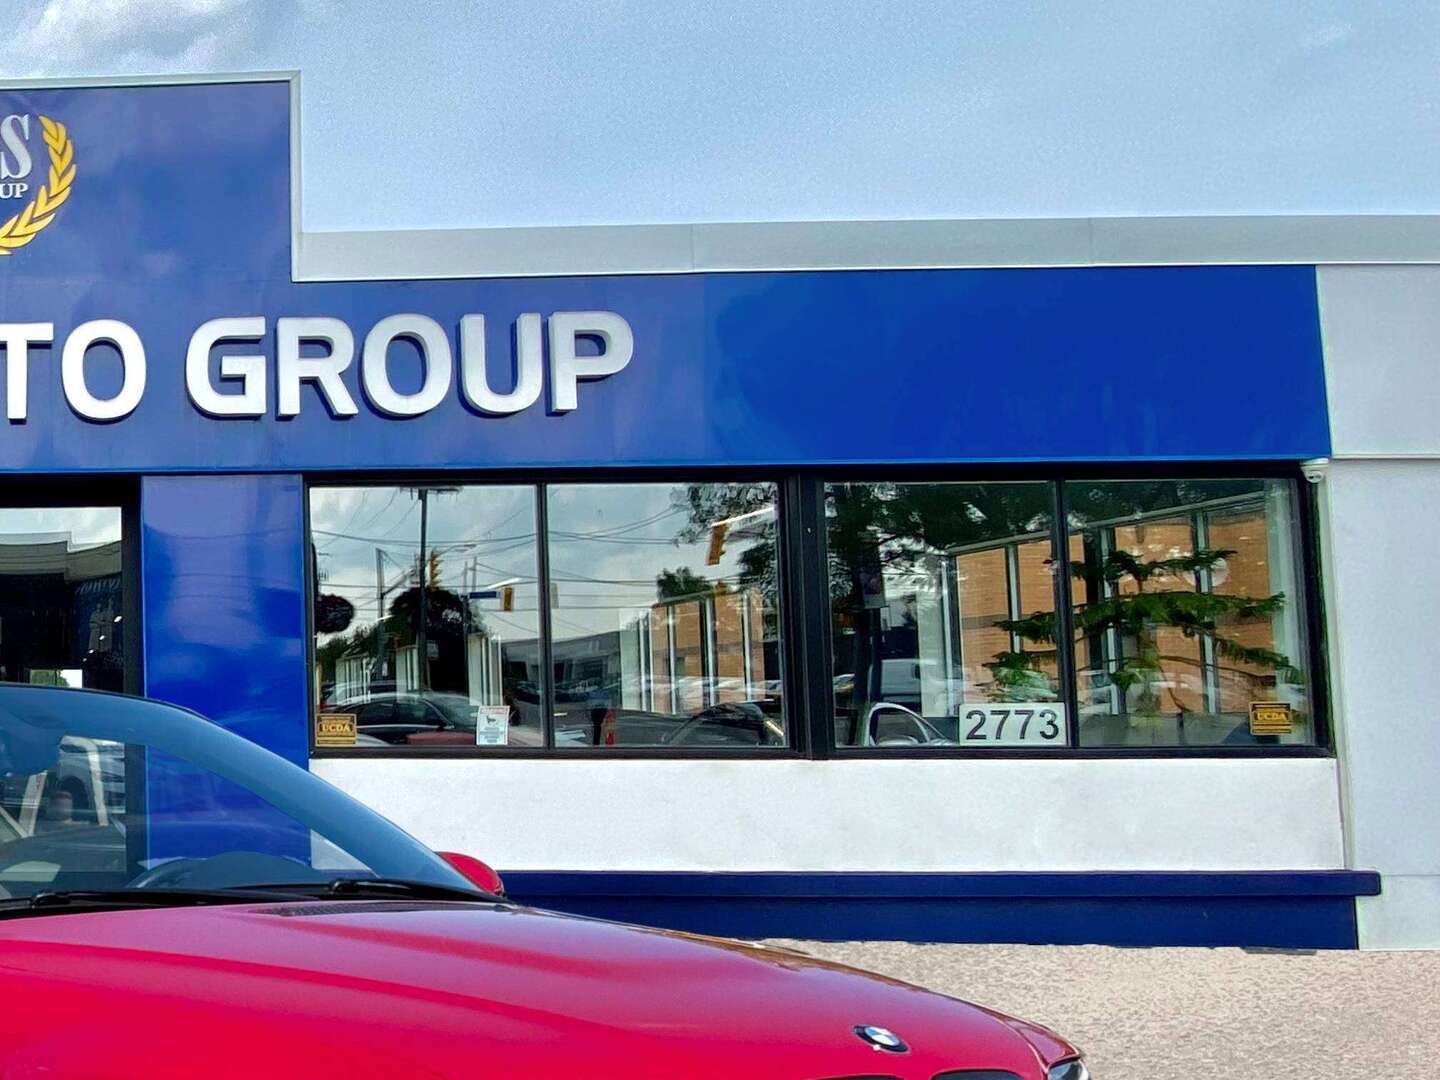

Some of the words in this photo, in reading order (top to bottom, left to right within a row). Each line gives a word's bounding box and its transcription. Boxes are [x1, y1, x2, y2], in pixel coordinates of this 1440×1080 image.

[185, 311, 634, 418] GROUP
[321, 722, 352, 732] UCDA
[966, 709, 1059, 740] 2773
